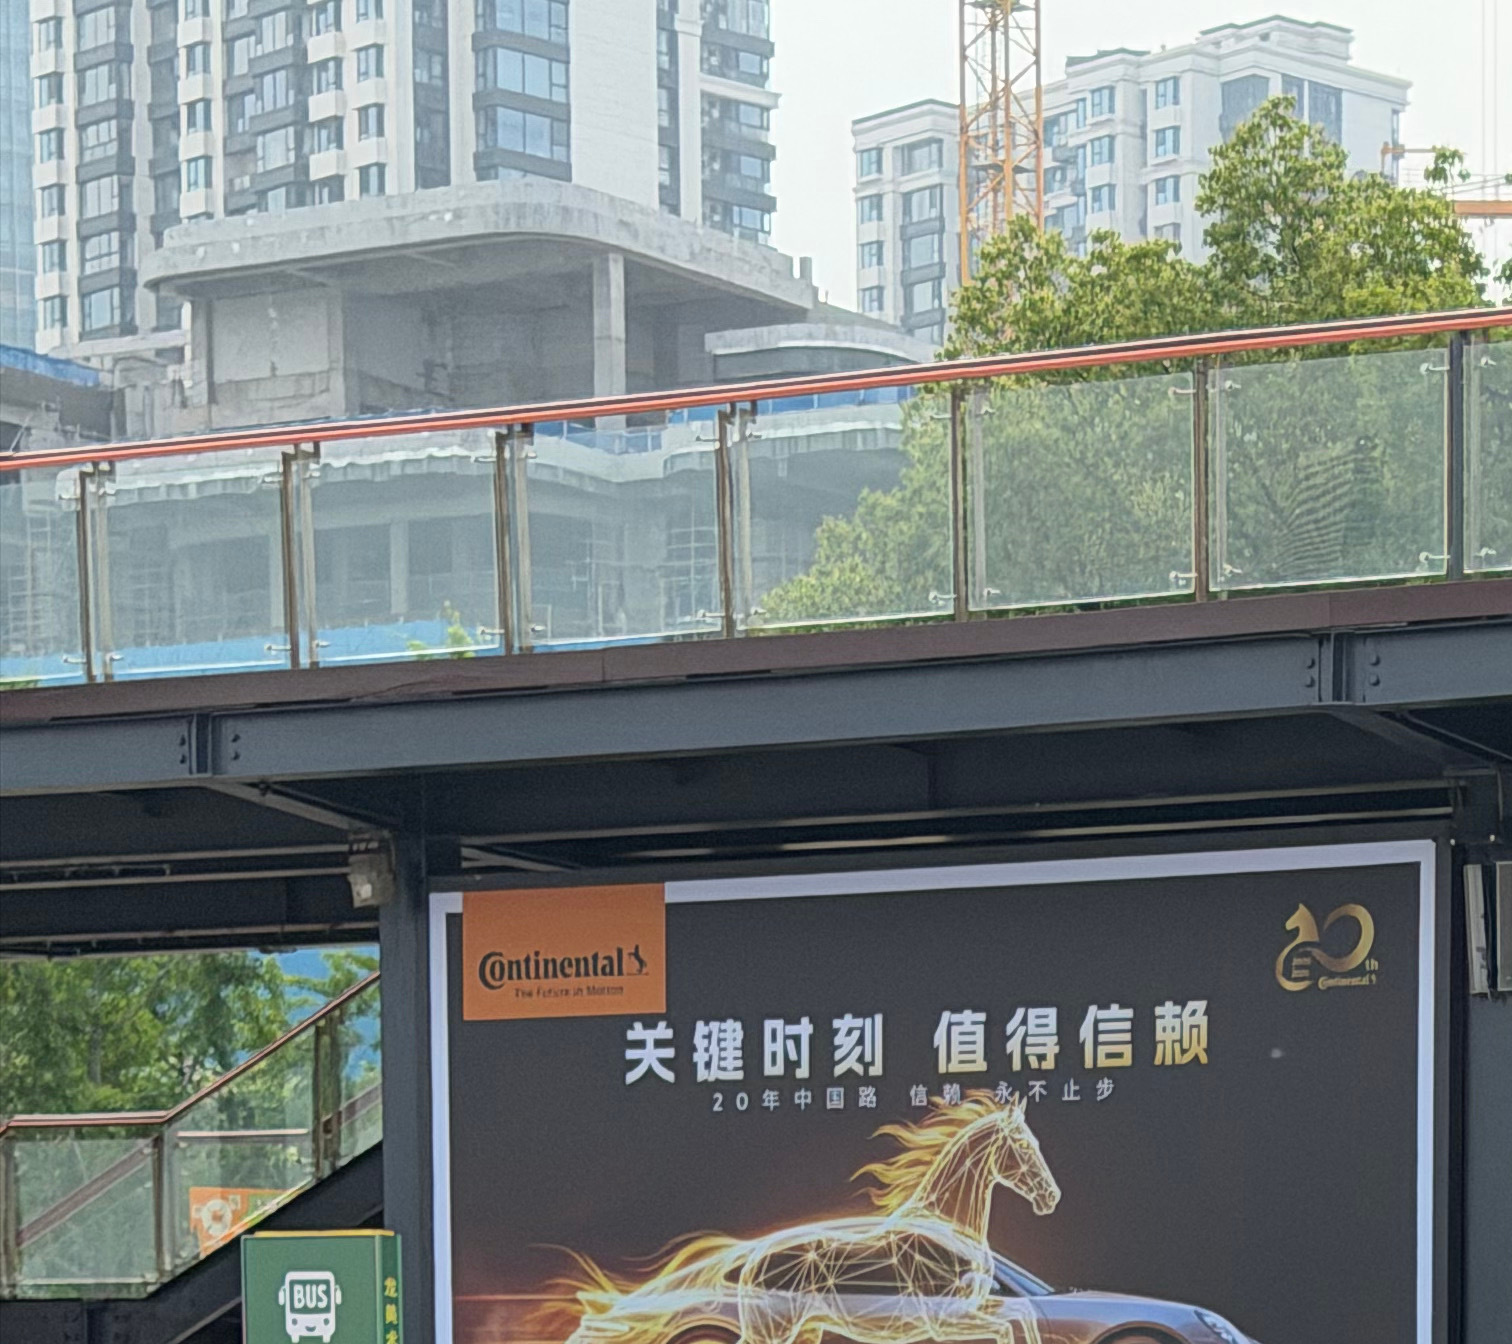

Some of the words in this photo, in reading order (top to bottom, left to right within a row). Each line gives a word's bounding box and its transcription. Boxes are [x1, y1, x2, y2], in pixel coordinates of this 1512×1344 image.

[479, 946, 624, 991] Continental
[625, 1013, 885, 1085] 关键时刻
[933, 1000, 1210, 1075] 值得信赖
[712, 1087, 879, 1113] 20年中国路
[293, 1283, 329, 1309] BUS
